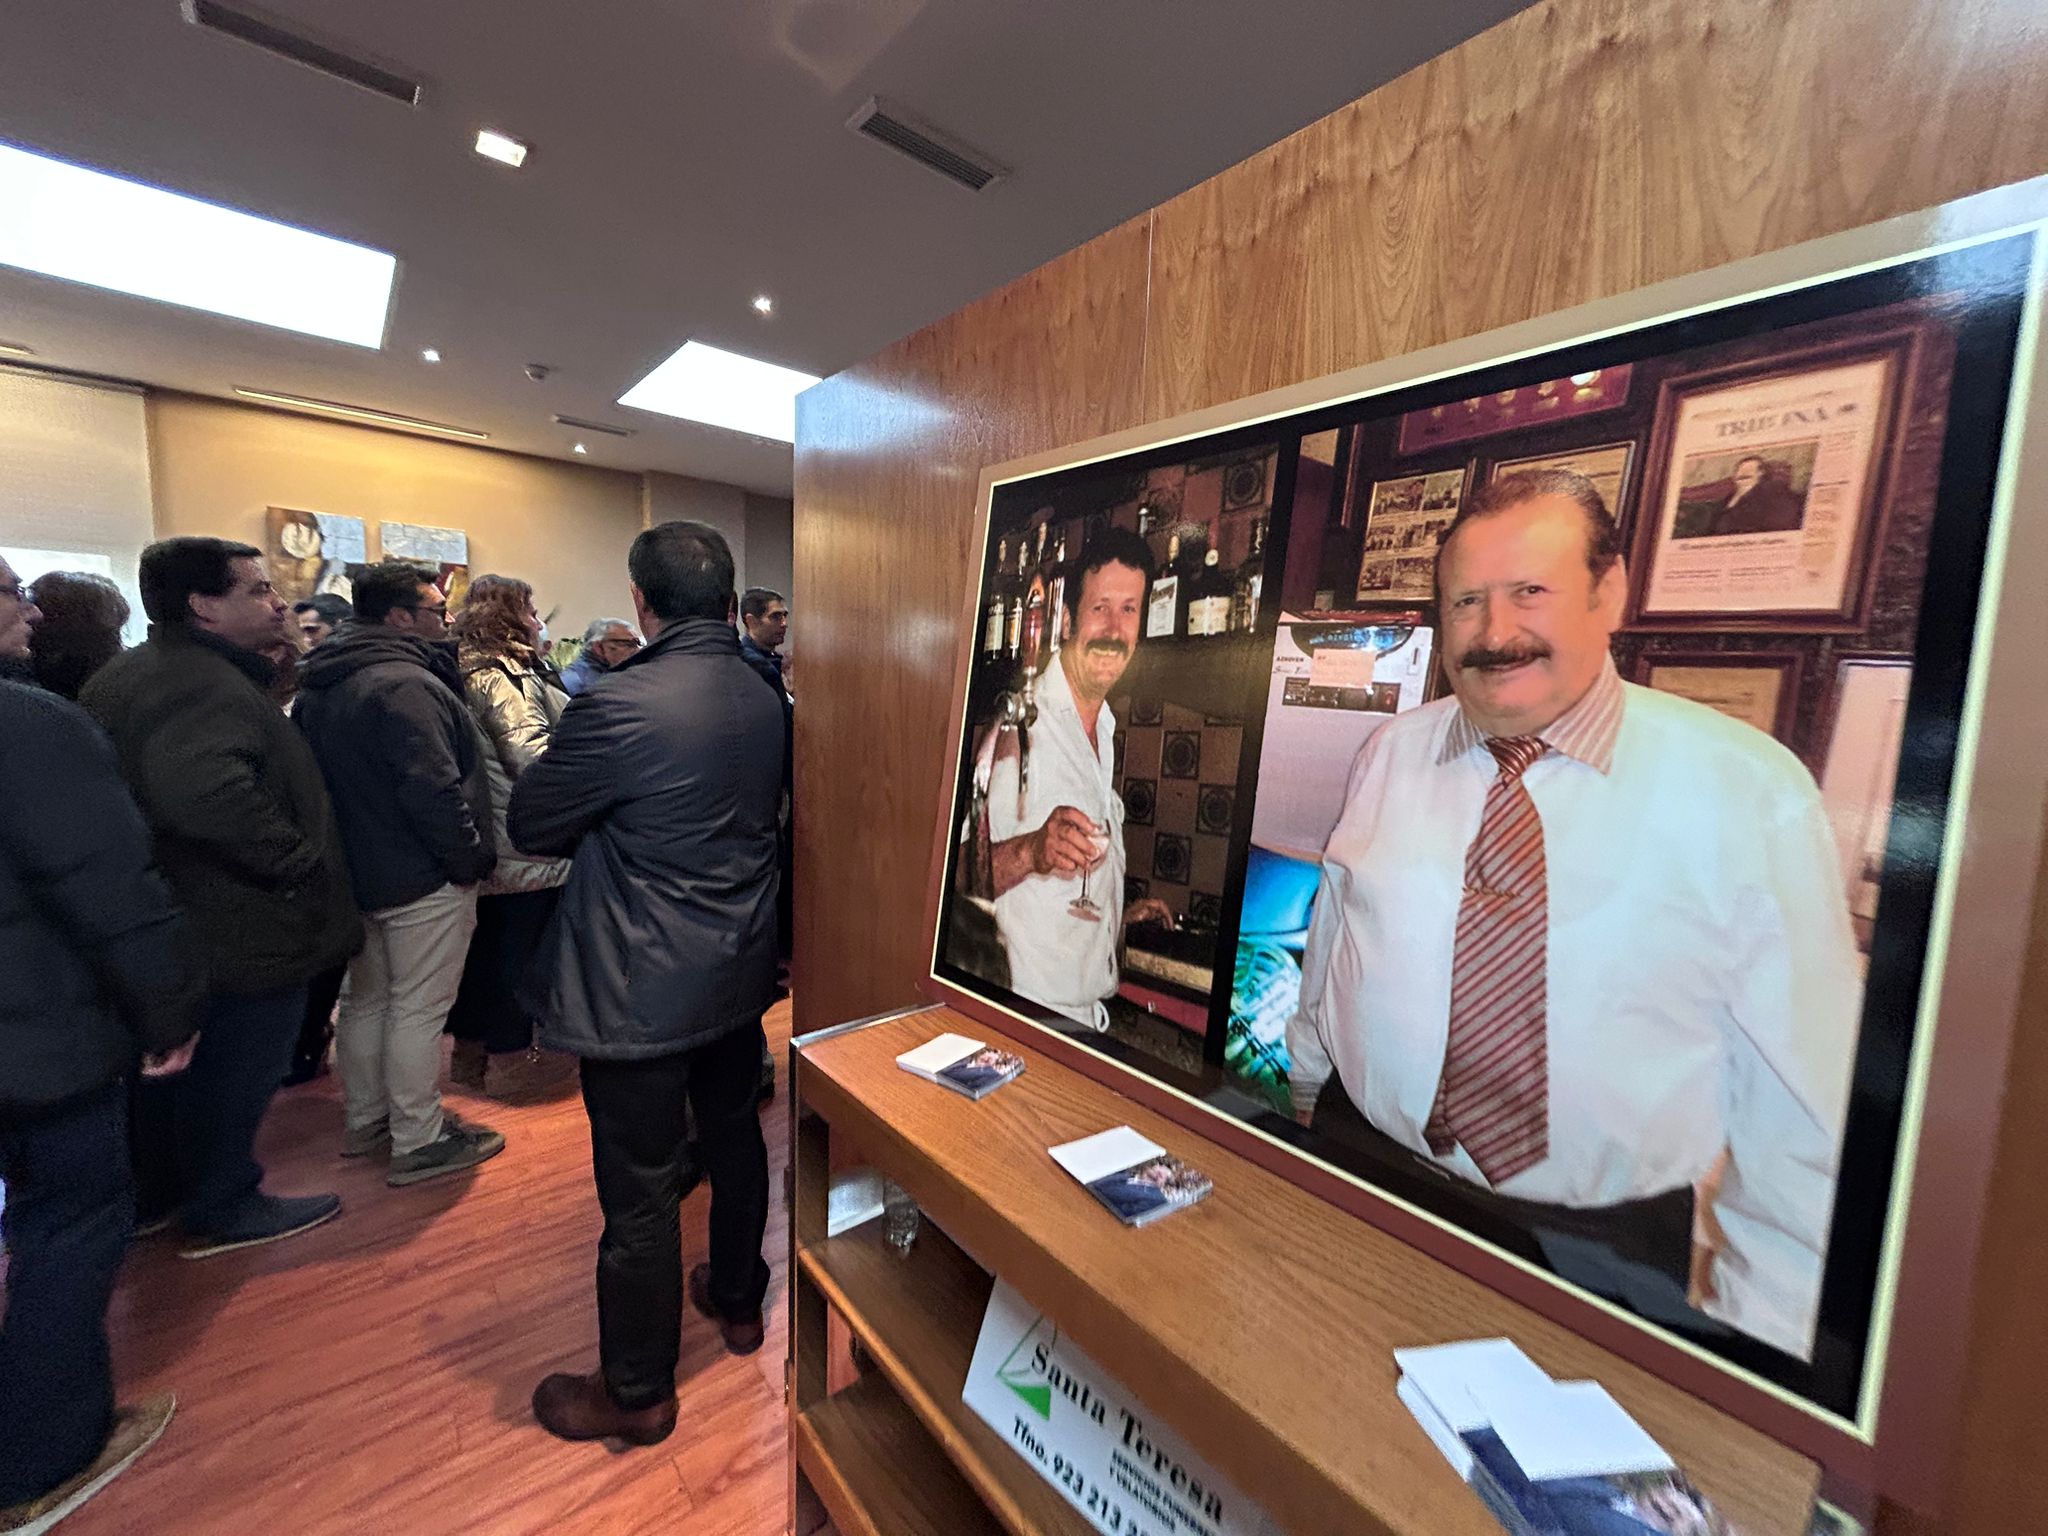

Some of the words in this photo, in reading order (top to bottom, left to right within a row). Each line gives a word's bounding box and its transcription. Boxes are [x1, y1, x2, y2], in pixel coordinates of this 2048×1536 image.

[1014, 1413, 1048, 1466] Tfno.
[1053, 1451, 1084, 1496] 923
[1087, 1483, 1121, 1531] 213
[1031, 1342, 1105, 1427] Santa
[1119, 1406, 1222, 1527] Teresa
